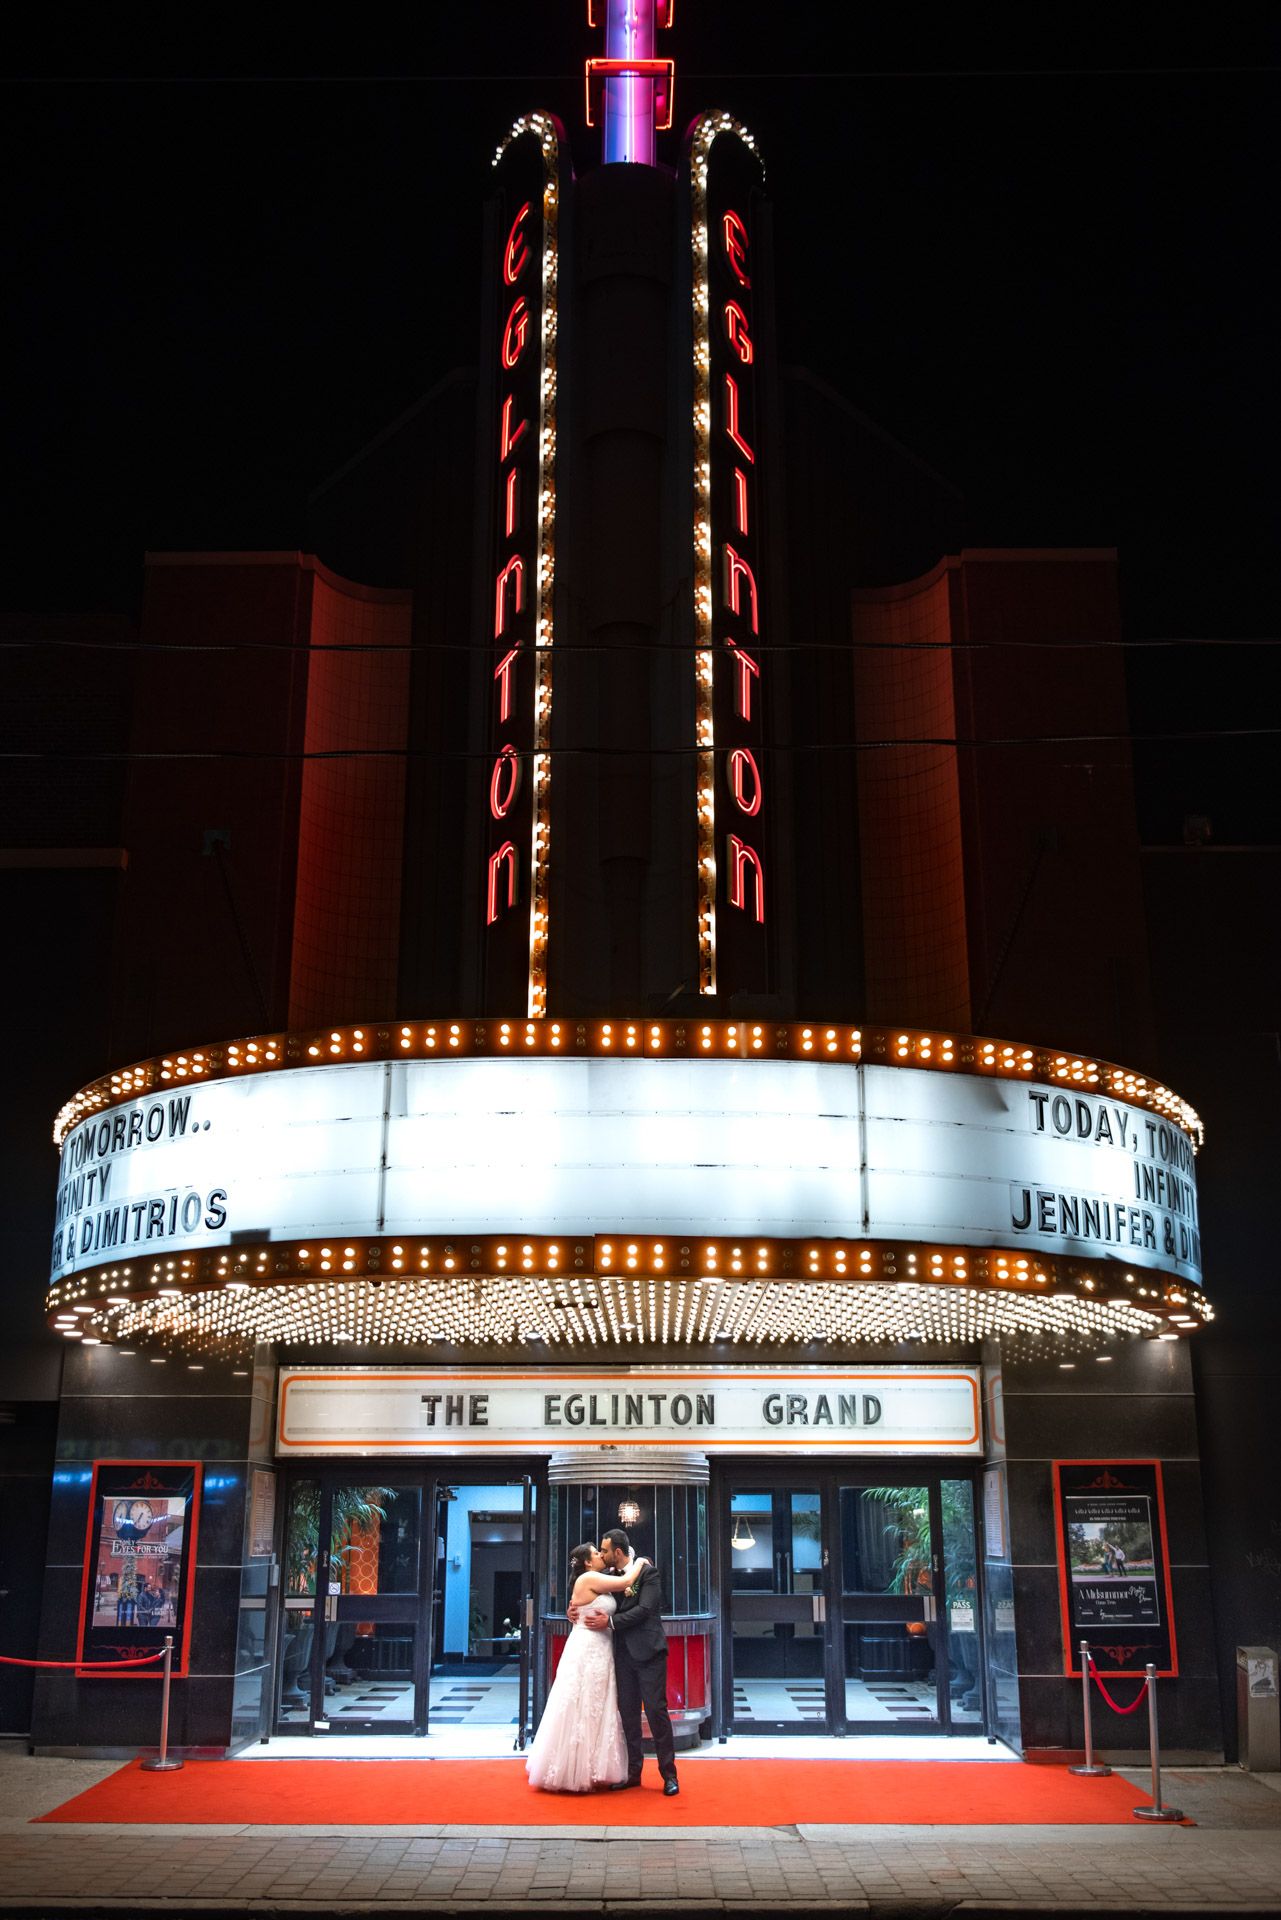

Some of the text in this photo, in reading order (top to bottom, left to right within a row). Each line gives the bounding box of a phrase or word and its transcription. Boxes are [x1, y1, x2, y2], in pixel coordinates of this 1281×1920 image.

[68, 1096, 211, 1174] TOMORROW..
[1028, 1090, 1138, 1152] TODAY,
[66, 1222, 75, 1261] &
[80, 1188, 228, 1255] DIMITRIOS
[1012, 1189, 1156, 1250] JENNIFER
[1163, 1216, 1176, 1255] &
[421, 1393, 882, 1426] THE EGLINTON GRAND
[154, 1545, 169, 1554] YOU
[952, 1601, 971, 1609] PASS
